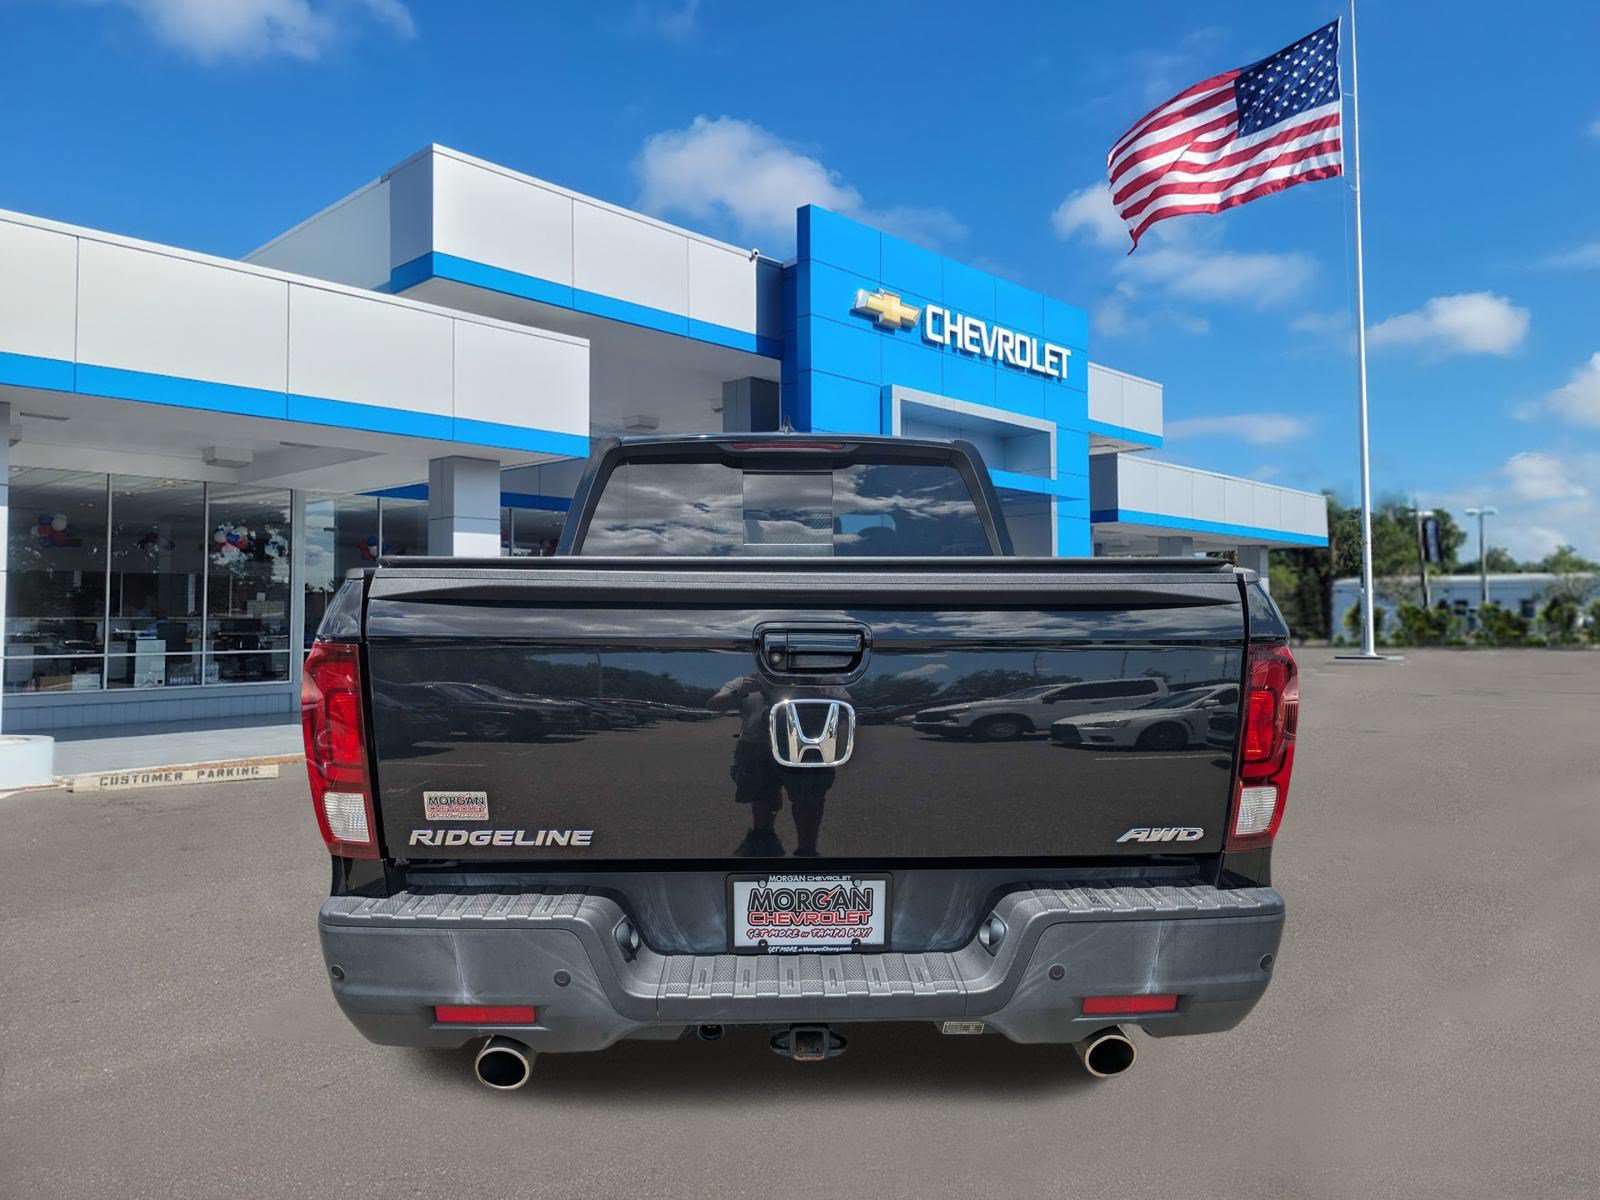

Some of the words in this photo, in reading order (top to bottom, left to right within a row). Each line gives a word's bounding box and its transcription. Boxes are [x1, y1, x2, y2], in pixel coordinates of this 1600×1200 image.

[926, 305, 1071, 379] CHEVROLET
[99, 771, 183, 786] CUSTOMER
[197, 766, 259, 779] PARKING
[428, 795, 485, 806] MORGAN
[408, 829, 594, 847] RIDGELINE
[1116, 827, 1204, 842] AWD
[748, 885, 873, 912] MORGAN
[748, 911, 872, 926] CHEVROLET
[746, 928, 770, 939] GET
[769, 928, 800, 938] MORE
[810, 928, 846, 938] TAMPA
[847, 927, 873, 938] BAY!
